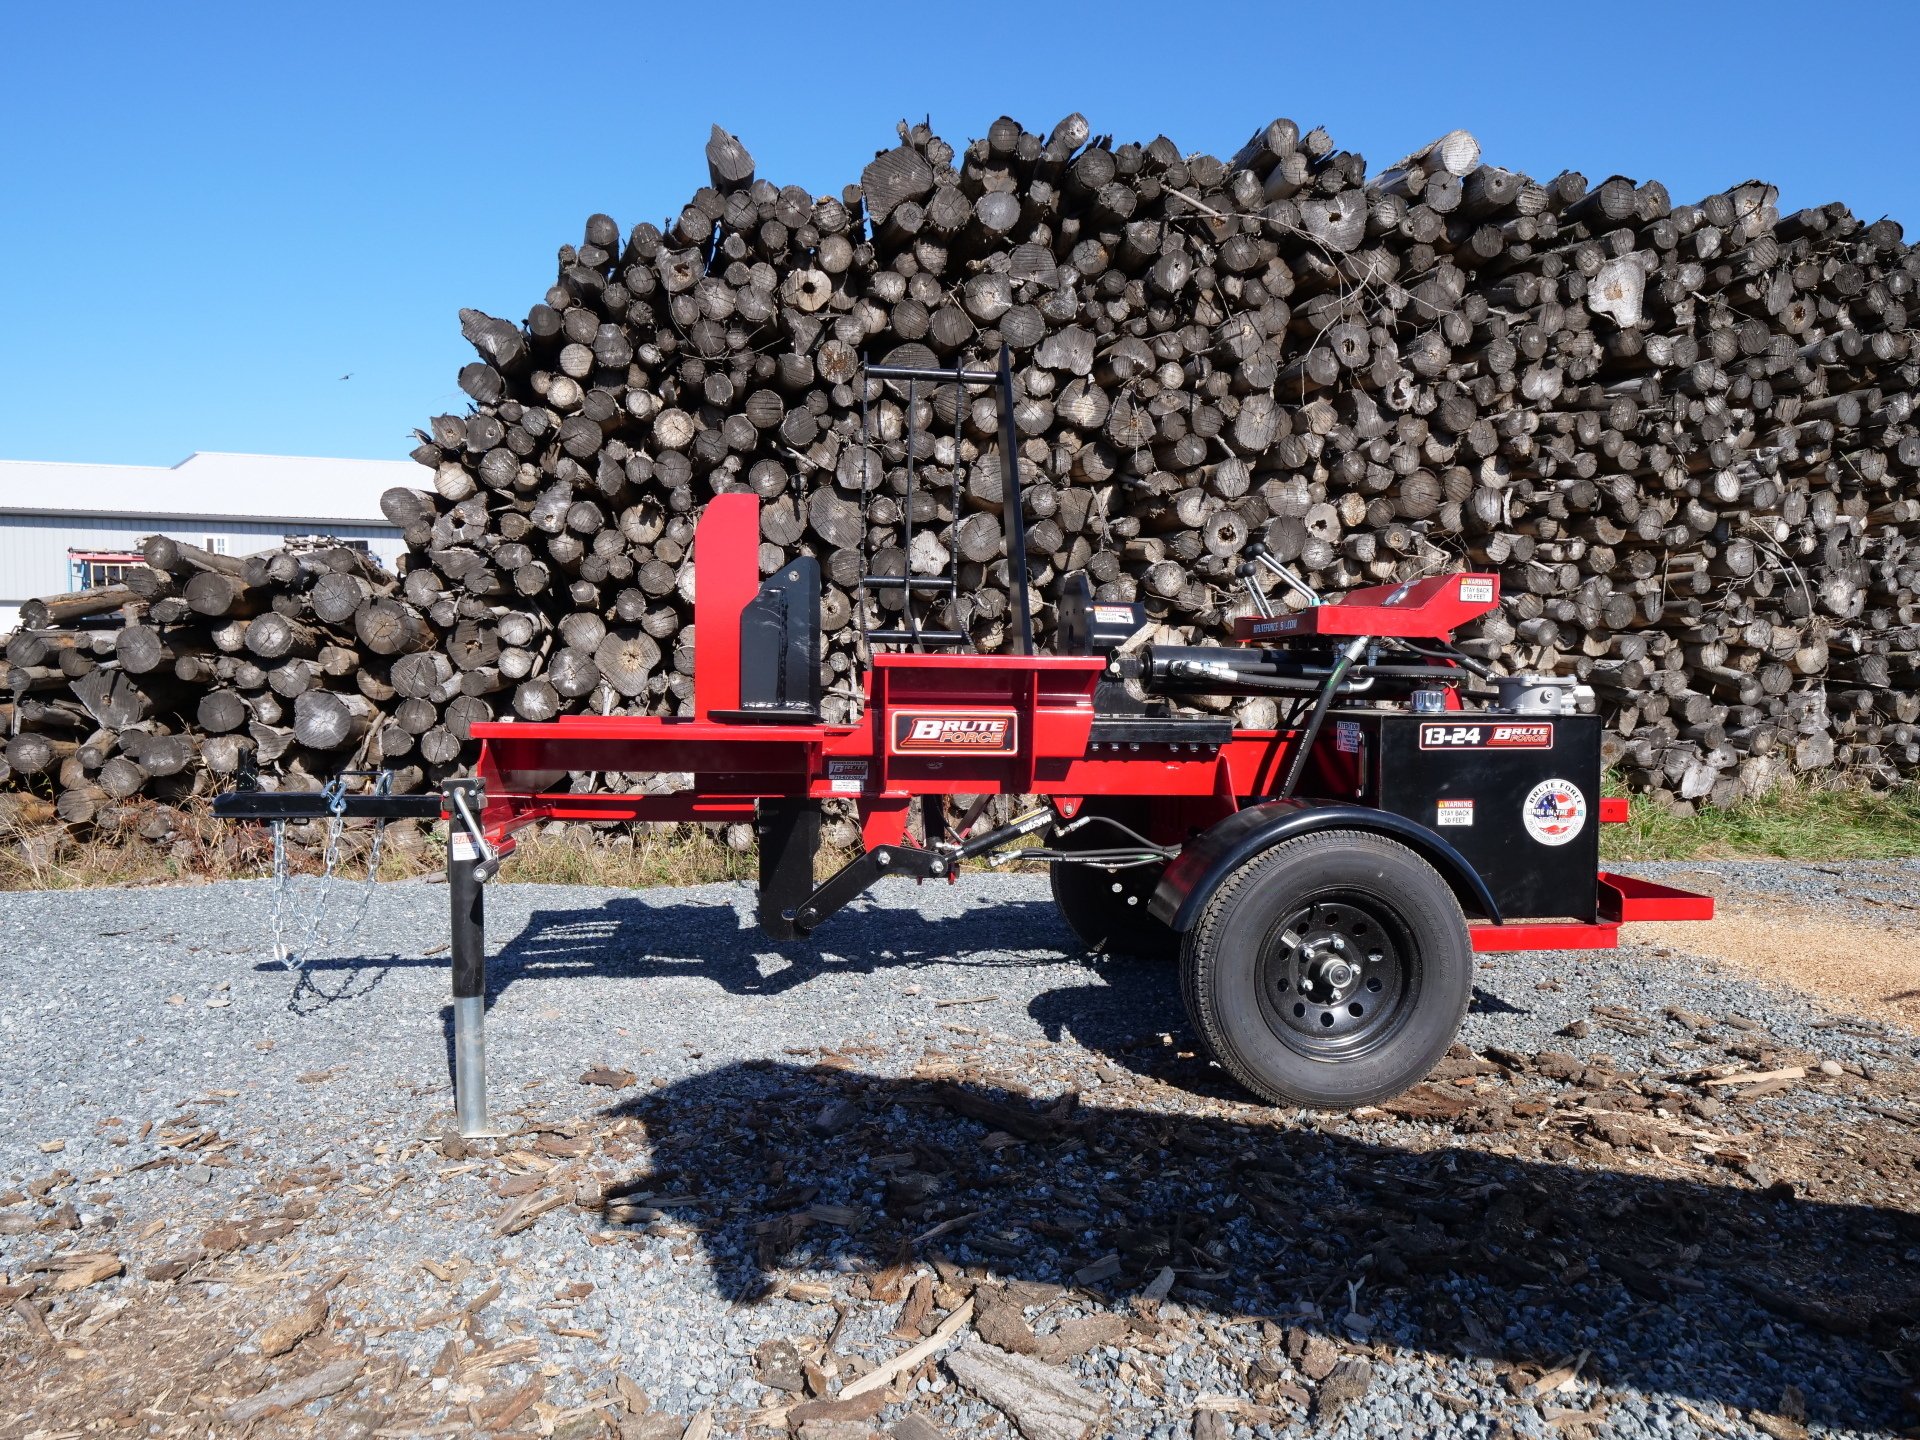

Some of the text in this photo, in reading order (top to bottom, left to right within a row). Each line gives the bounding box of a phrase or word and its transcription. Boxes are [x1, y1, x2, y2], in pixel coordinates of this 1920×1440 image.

[911, 720, 1006, 739] BRUTE
[1425, 727, 1481, 745] 13-24
[1492, 727, 1549, 740] BRUTE
[939, 732, 1004, 743] FORCE
[1509, 734, 1548, 743] FORCE
[1529, 782, 1556, 804] BRUTE
[1560, 782, 1582, 805] FORCE
[1526, 808, 1545, 816] MADE
[1546, 808, 1554, 816] IN
[1556, 808, 1568, 816] THE
